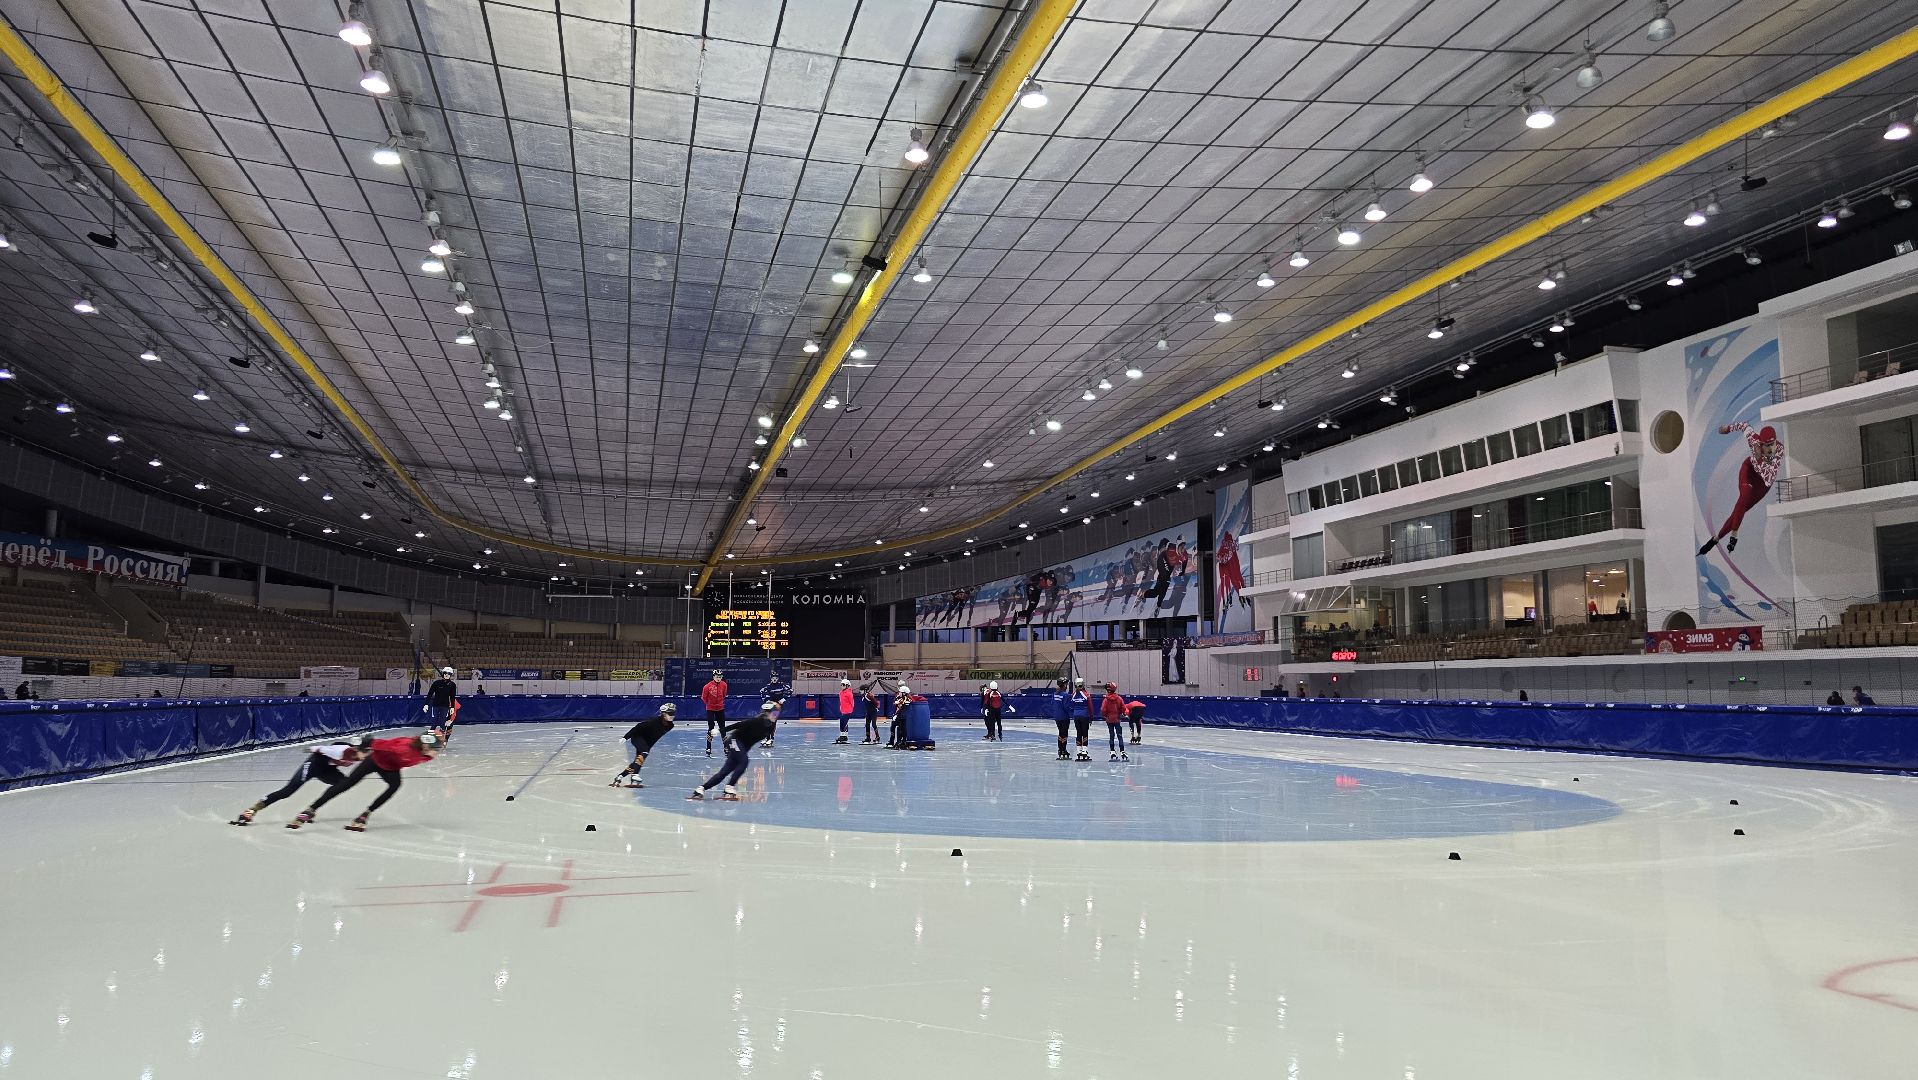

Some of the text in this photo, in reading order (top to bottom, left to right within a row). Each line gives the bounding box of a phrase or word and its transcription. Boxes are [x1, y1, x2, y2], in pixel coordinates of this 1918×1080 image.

[0, 538, 190, 584] ерёд, Россия!
[792, 594, 866, 605] КОЛОМНА
[969, 671, 994, 680] СПОРТ
[1001, 671, 1031, 680] НОРМА
